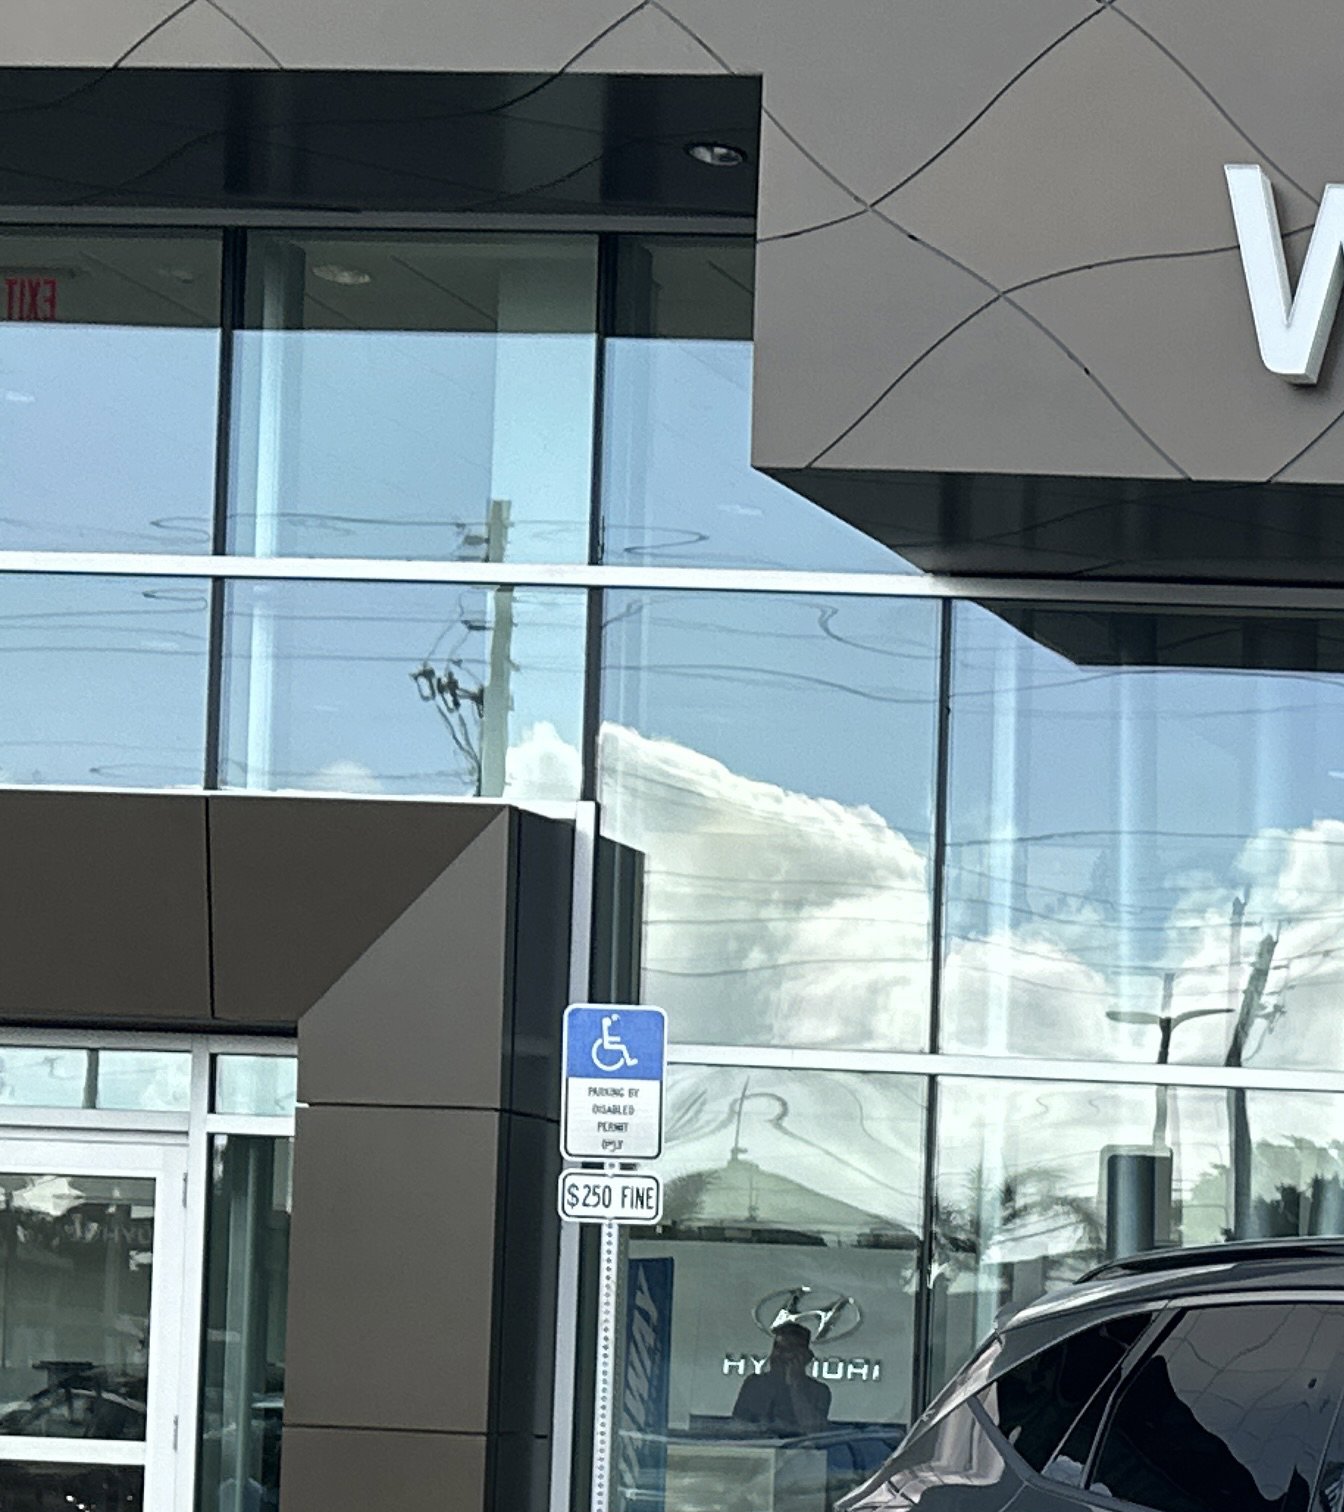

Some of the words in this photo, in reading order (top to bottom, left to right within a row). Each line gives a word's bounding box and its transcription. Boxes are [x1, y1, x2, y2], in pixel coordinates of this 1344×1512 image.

[587, 1086, 625, 1099] PARKING
[628, 1088, 640, 1099] BY
[592, 1104, 635, 1116] DISABLED
[597, 1122, 629, 1133] PERMIT
[567, 1183, 612, 1210] $250
[621, 1186, 655, 1210] FINE
[722, 1355, 880, 1380] HYDAI
